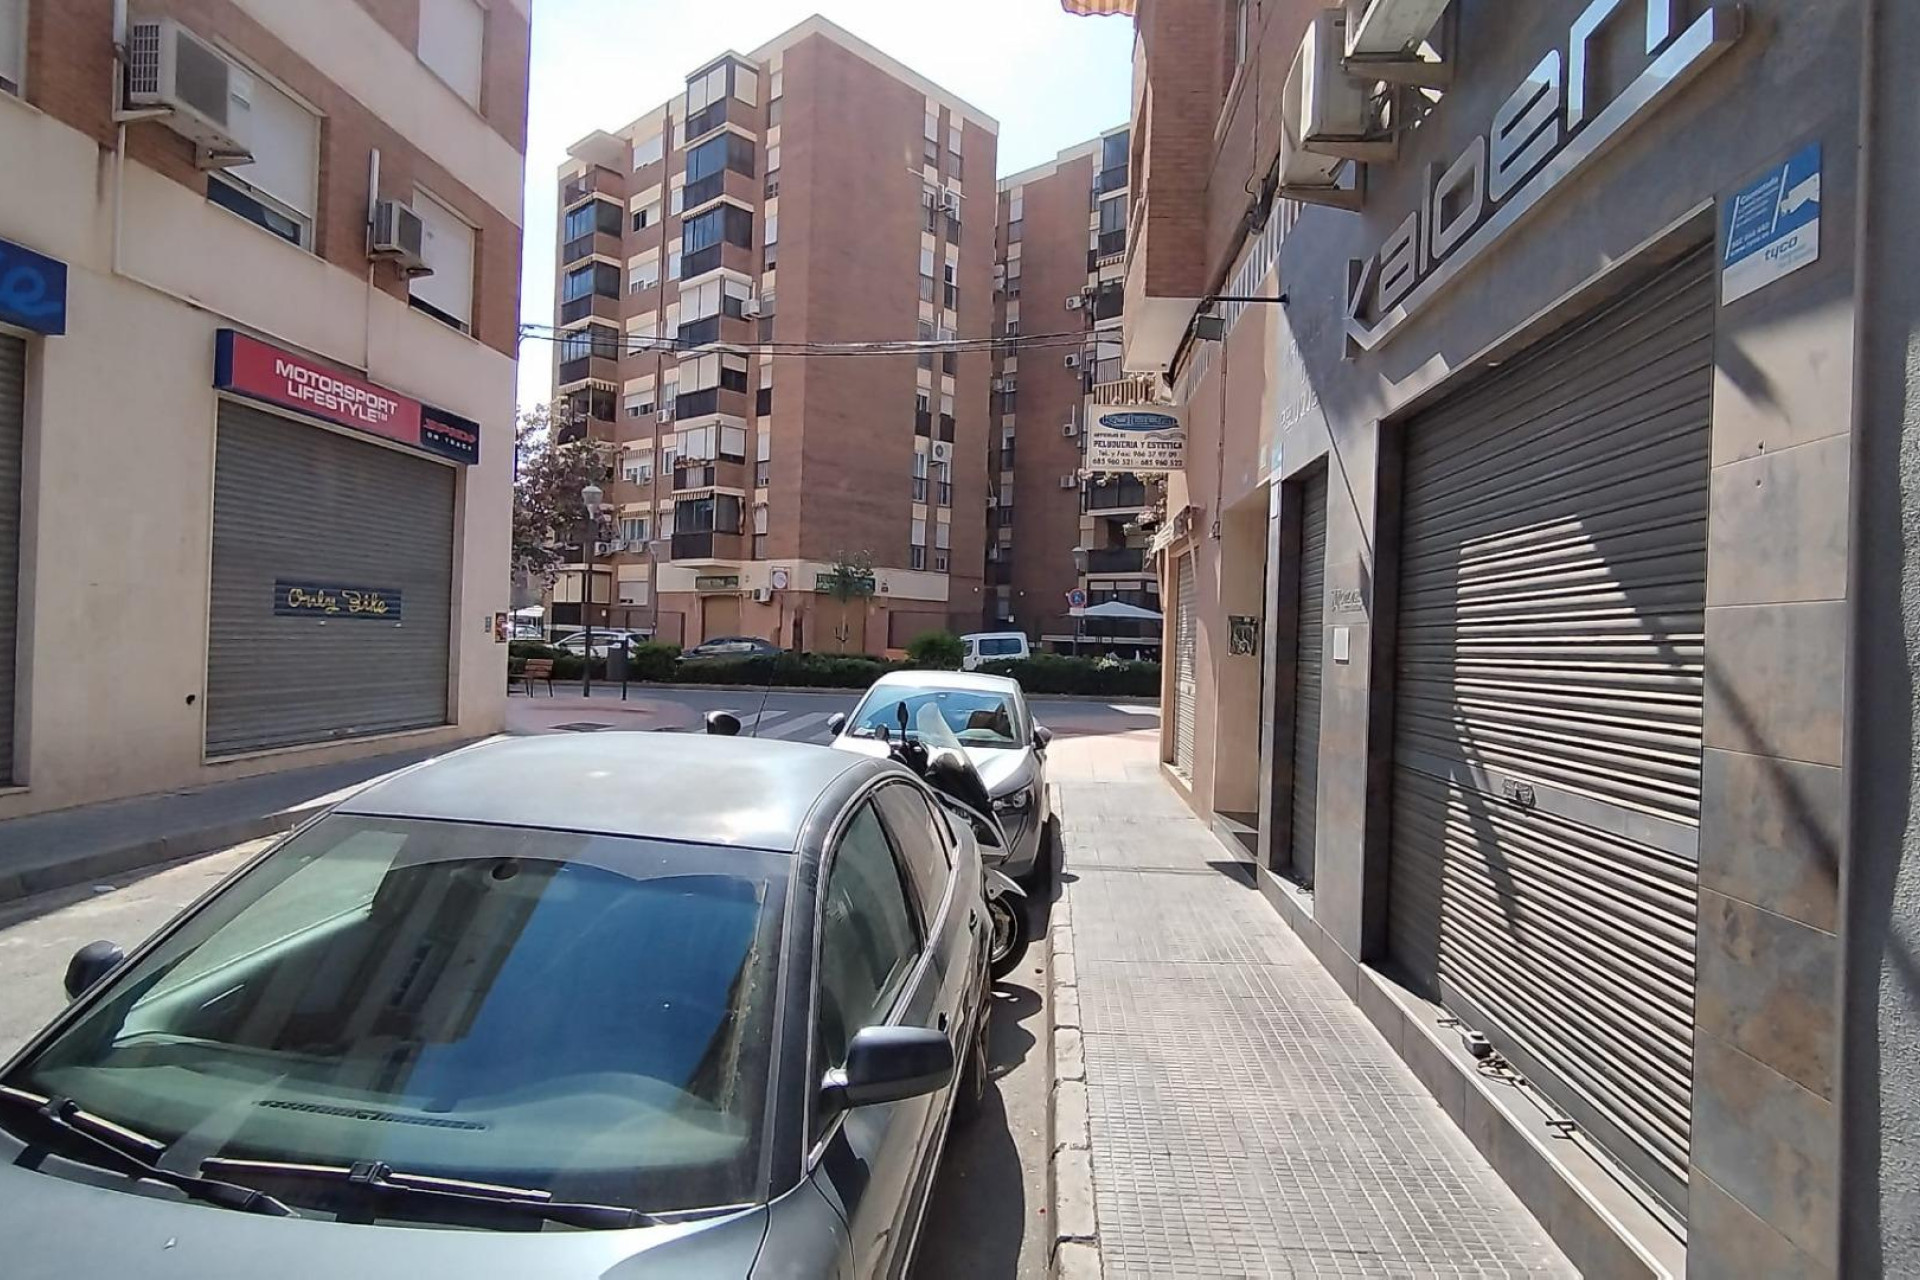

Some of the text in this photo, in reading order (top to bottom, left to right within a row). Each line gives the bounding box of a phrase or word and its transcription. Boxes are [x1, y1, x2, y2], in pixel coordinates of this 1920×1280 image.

[1764, 234, 1798, 261] tyco
[275, 359, 398, 415] MOTORSPORT
[1147, 441, 1183, 449] ESTETICA
[288, 588, 389, 615] Only Bike
